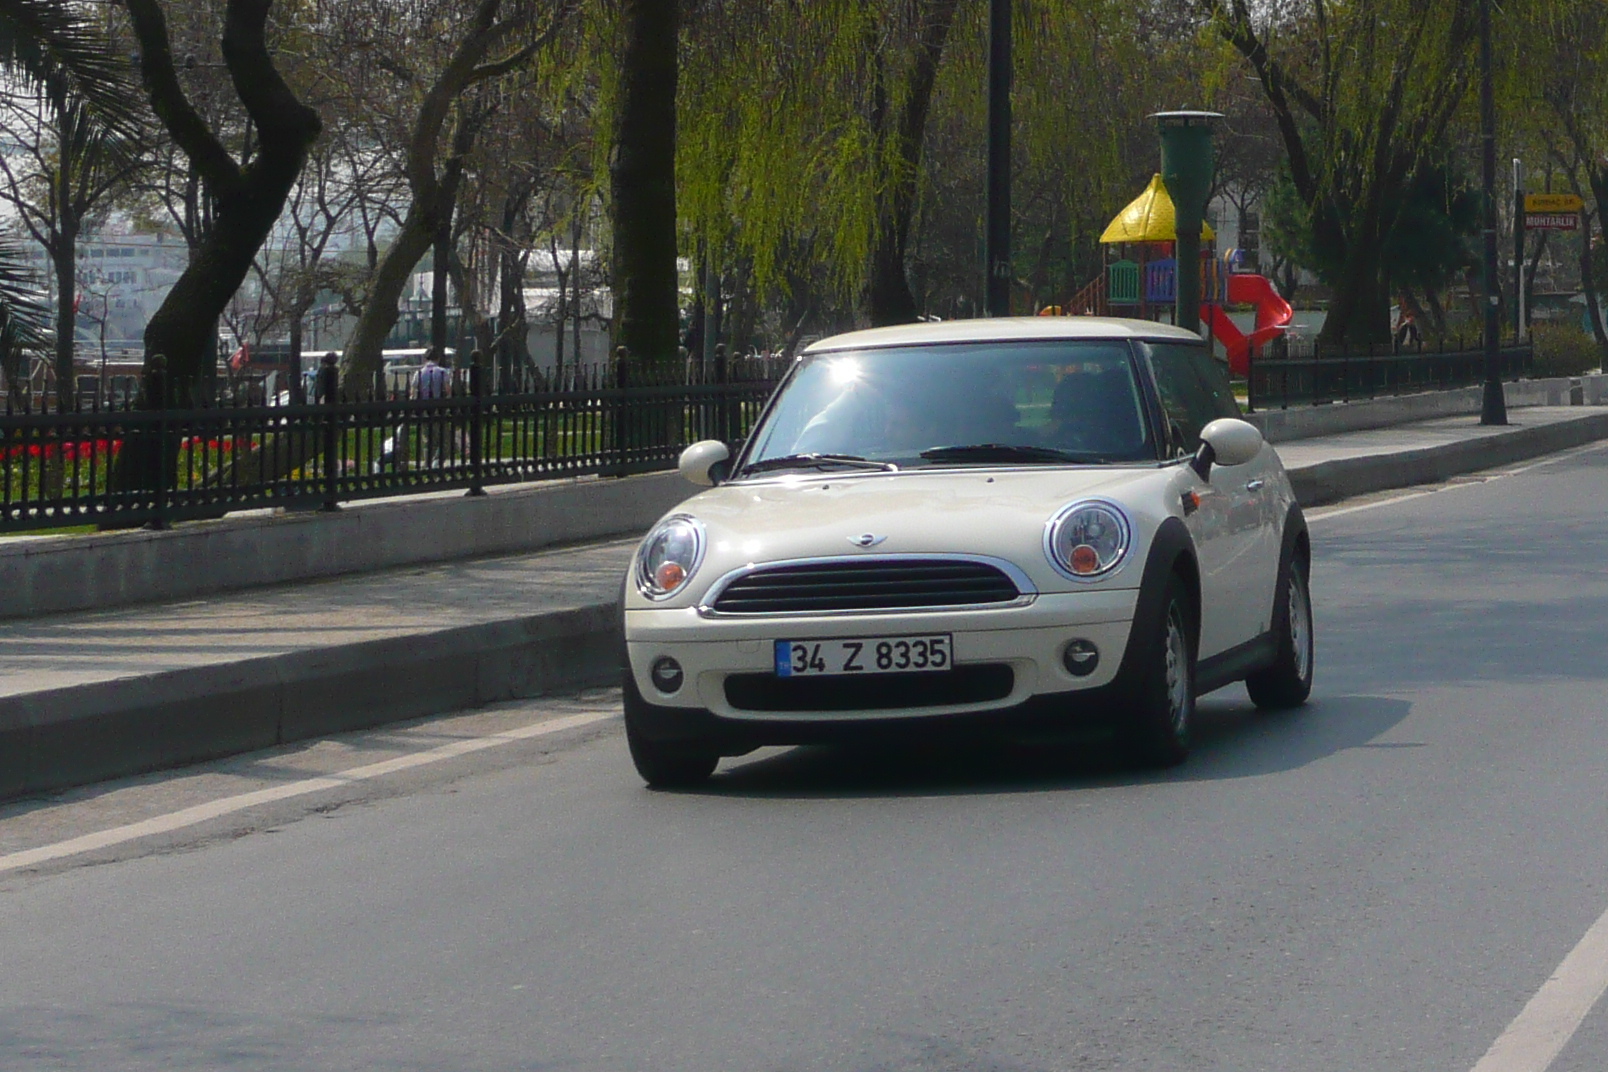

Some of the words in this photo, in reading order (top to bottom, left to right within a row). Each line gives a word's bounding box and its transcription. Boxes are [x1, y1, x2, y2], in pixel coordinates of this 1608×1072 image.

[1525, 216, 1575, 227] MUHTARLIK
[791, 643, 826, 673] 34
[842, 642, 864, 671] Z
[875, 638, 948, 670] 8335
